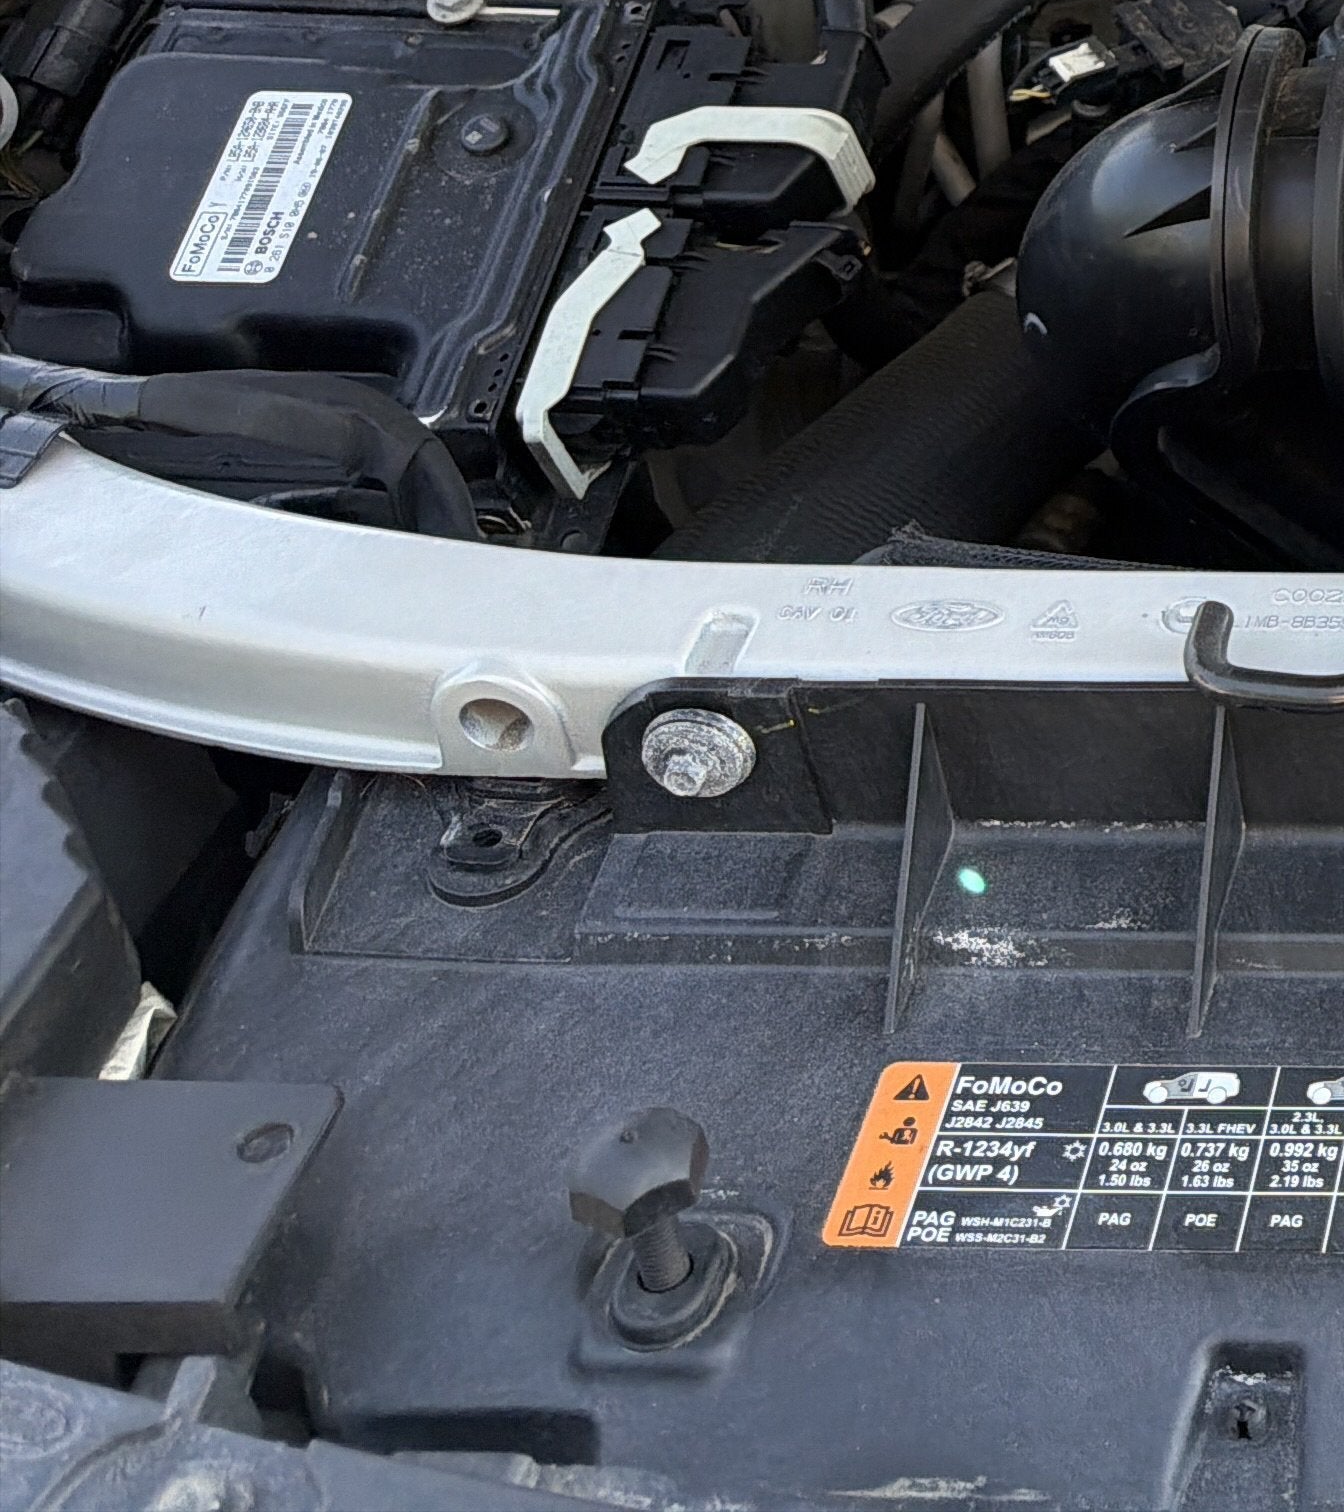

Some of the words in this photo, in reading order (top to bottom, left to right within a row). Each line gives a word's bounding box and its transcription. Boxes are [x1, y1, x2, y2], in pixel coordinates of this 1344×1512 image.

[255, 211, 285, 255] BOSCH
[181, 215, 220, 273] FoMoCo
[803, 576, 854, 595] RH
[955, 1076, 1062, 1095] FoMoCo
[951, 1100, 987, 1112] SAE
[990, 1100, 1030, 1112] J639
[945, 1117, 992, 1129] J2842
[996, 1117, 1043, 1129] J2845
[1102, 1122, 1129, 1133] 3.0L
[1134, 1122, 1144, 1133] &
[1147, 1122, 1176, 1133] 3.3L
[1186, 1123, 1214, 1134] 3.3L
[1217, 1123, 1256, 1134] FHEV
[1269, 1123, 1297, 1135] 3.0L
[1301, 1123, 1311, 1135] &
[1314, 1123, 1343, 1135] 3.3L
[937, 1141, 1035, 1161] R-1234yf
[1099, 1142, 1143, 1157] 0.680
[1146, 1142, 1167, 1160] kg
[1181, 1143, 1226, 1157] 0.737
[1229, 1143, 1249, 1160] kg
[1269, 1144, 1313, 1158] 0.992
[1317, 1144, 1338, 1161] kg
[1109, 1160, 1127, 1171] 24
[1130, 1162, 1148, 1172] oz
[1191, 1161, 1210, 1172] 26
[1212, 1163, 1230, 1173] oz
[1281, 1162, 1299, 1173] 35
[1302, 1164, 1319, 1173] oz
[928, 1165, 993, 1184] (GWP
[997, 1165, 1019, 1185] 4)
[1098, 1175, 1127, 1186] 1.50
[1129, 1175, 1151, 1187] lbs
[1181, 1176, 1209, 1187] 1.63
[1212, 1176, 1234, 1188] lbs
[1269, 1176, 1299, 1188] 2.19
[1302, 1176, 1324, 1188] lbs
[912, 1211, 956, 1226] PAG
[1098, 1213, 1131, 1225] PAG
[1185, 1214, 1218, 1227] POE
[1269, 1215, 1304, 1228] PAG
[907, 1227, 950, 1242] POE
